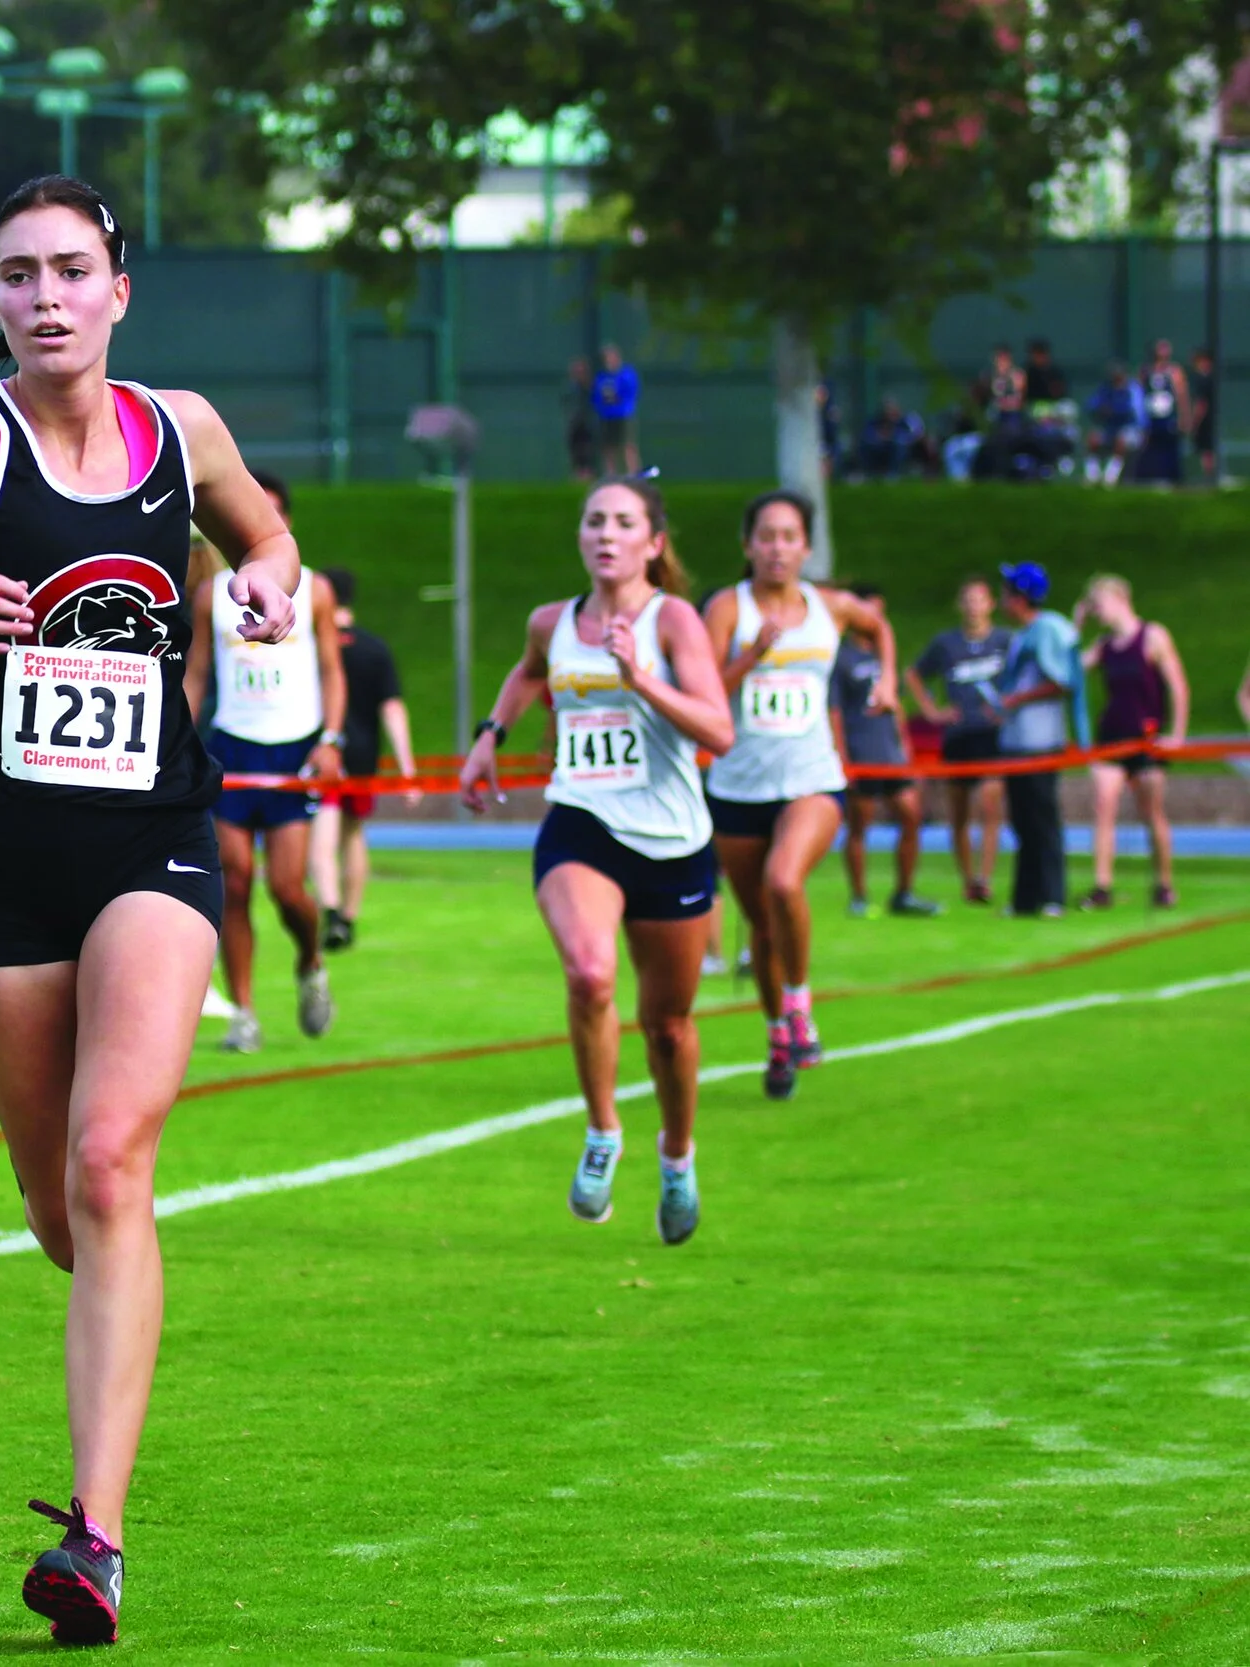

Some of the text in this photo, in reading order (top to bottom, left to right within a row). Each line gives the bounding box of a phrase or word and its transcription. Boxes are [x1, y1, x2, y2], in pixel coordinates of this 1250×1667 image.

[23, 652, 147, 673] Pomona-Pitzer
[166, 651, 183, 661] TM
[23, 664, 147, 685] XC Invitational
[15, 682, 146, 753] 1231
[568, 729, 640, 768] 1412
[23, 749, 135, 773] Claremont, CA
